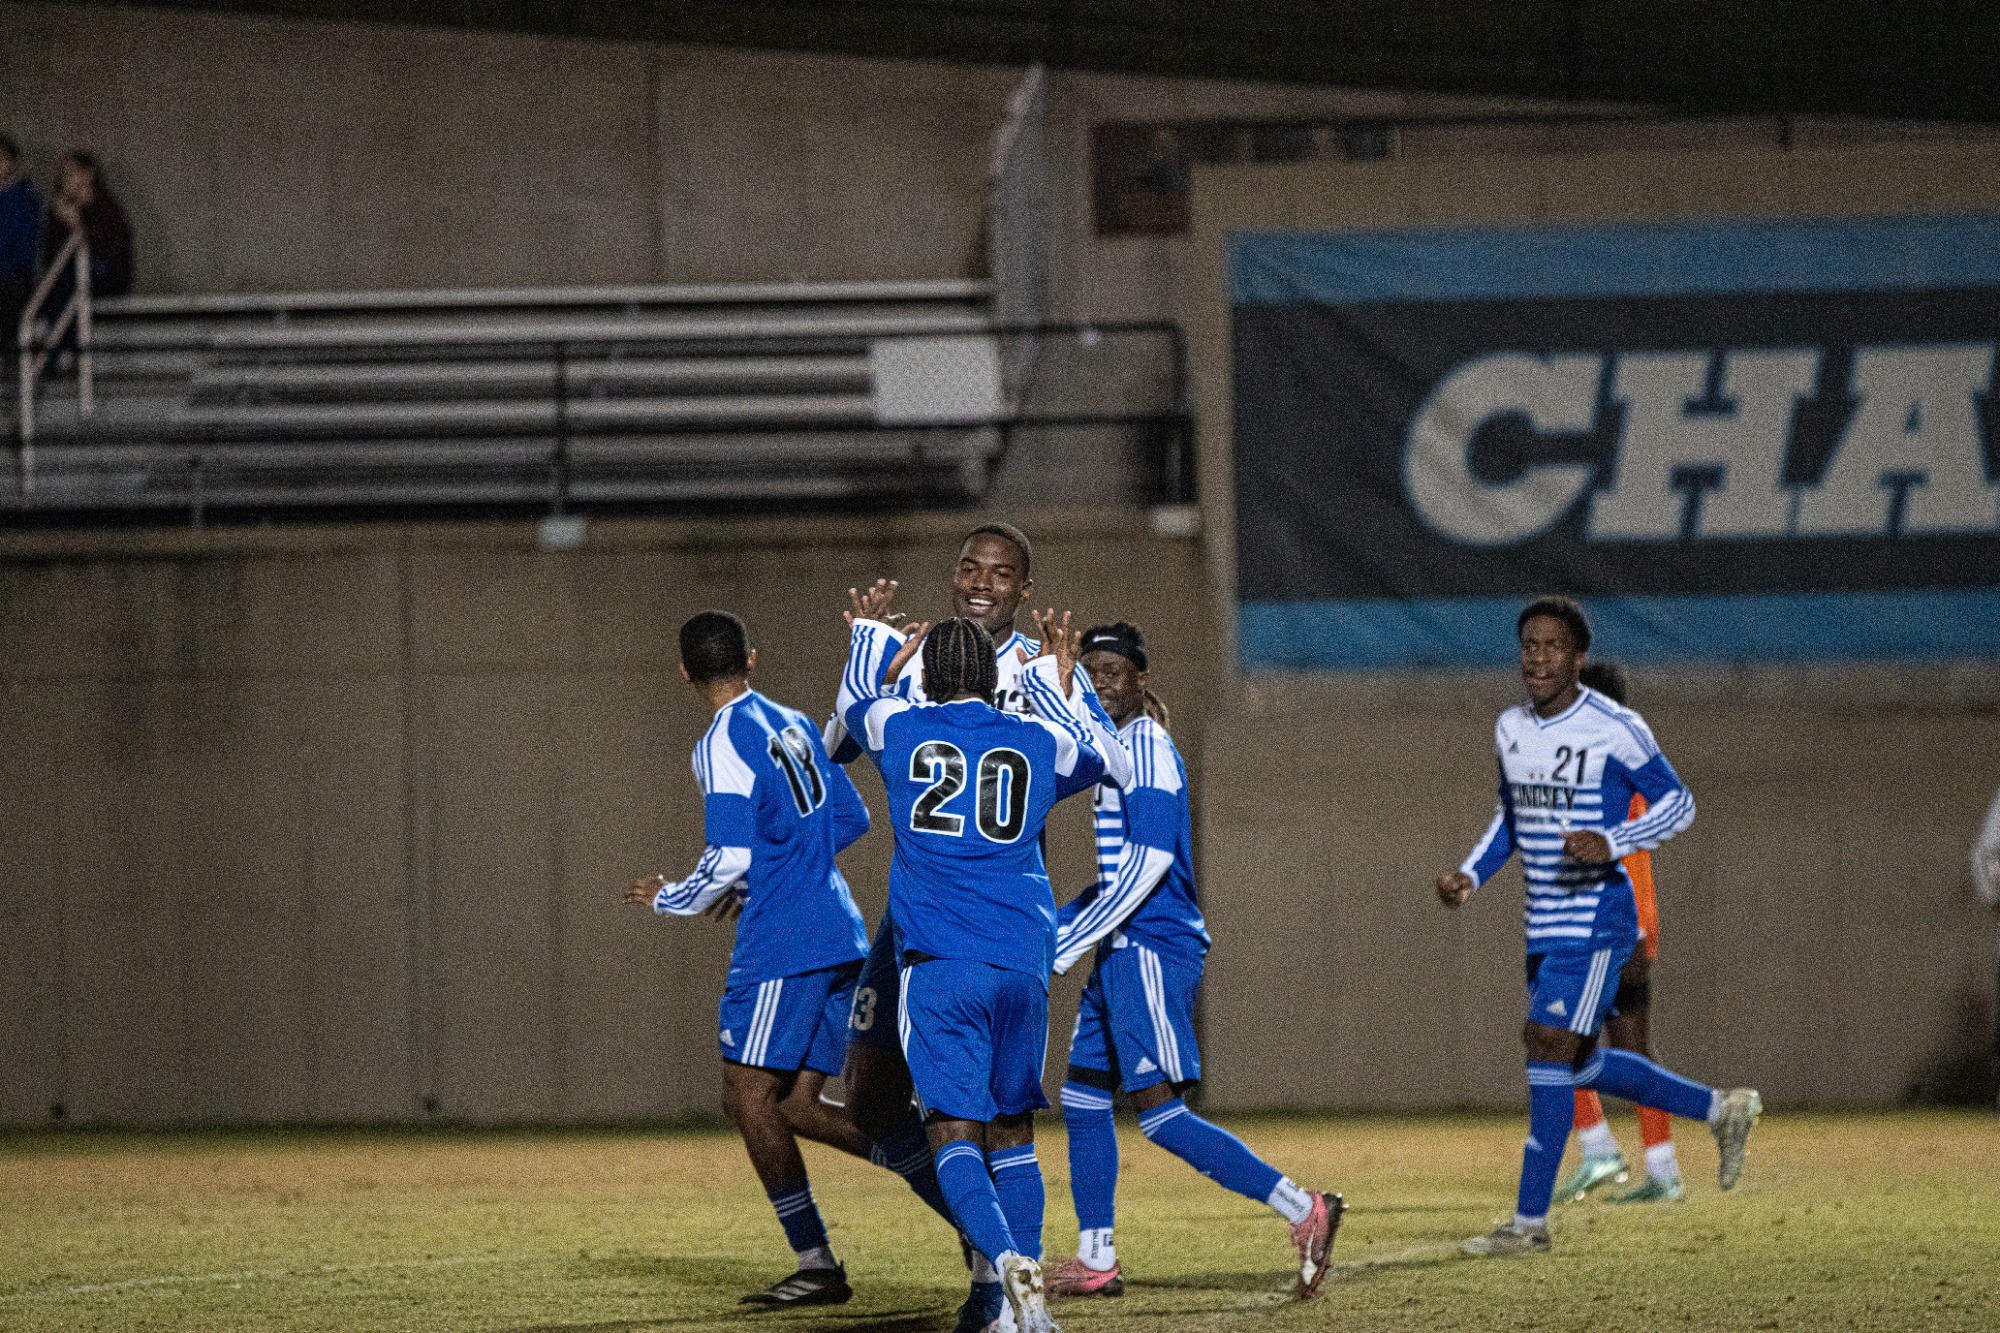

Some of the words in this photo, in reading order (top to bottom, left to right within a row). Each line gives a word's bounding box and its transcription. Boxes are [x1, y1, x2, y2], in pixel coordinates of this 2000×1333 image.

[1403, 342, 2000, 546] CHA
[909, 740, 1031, 844] 20
[1551, 745, 1588, 785] 21
